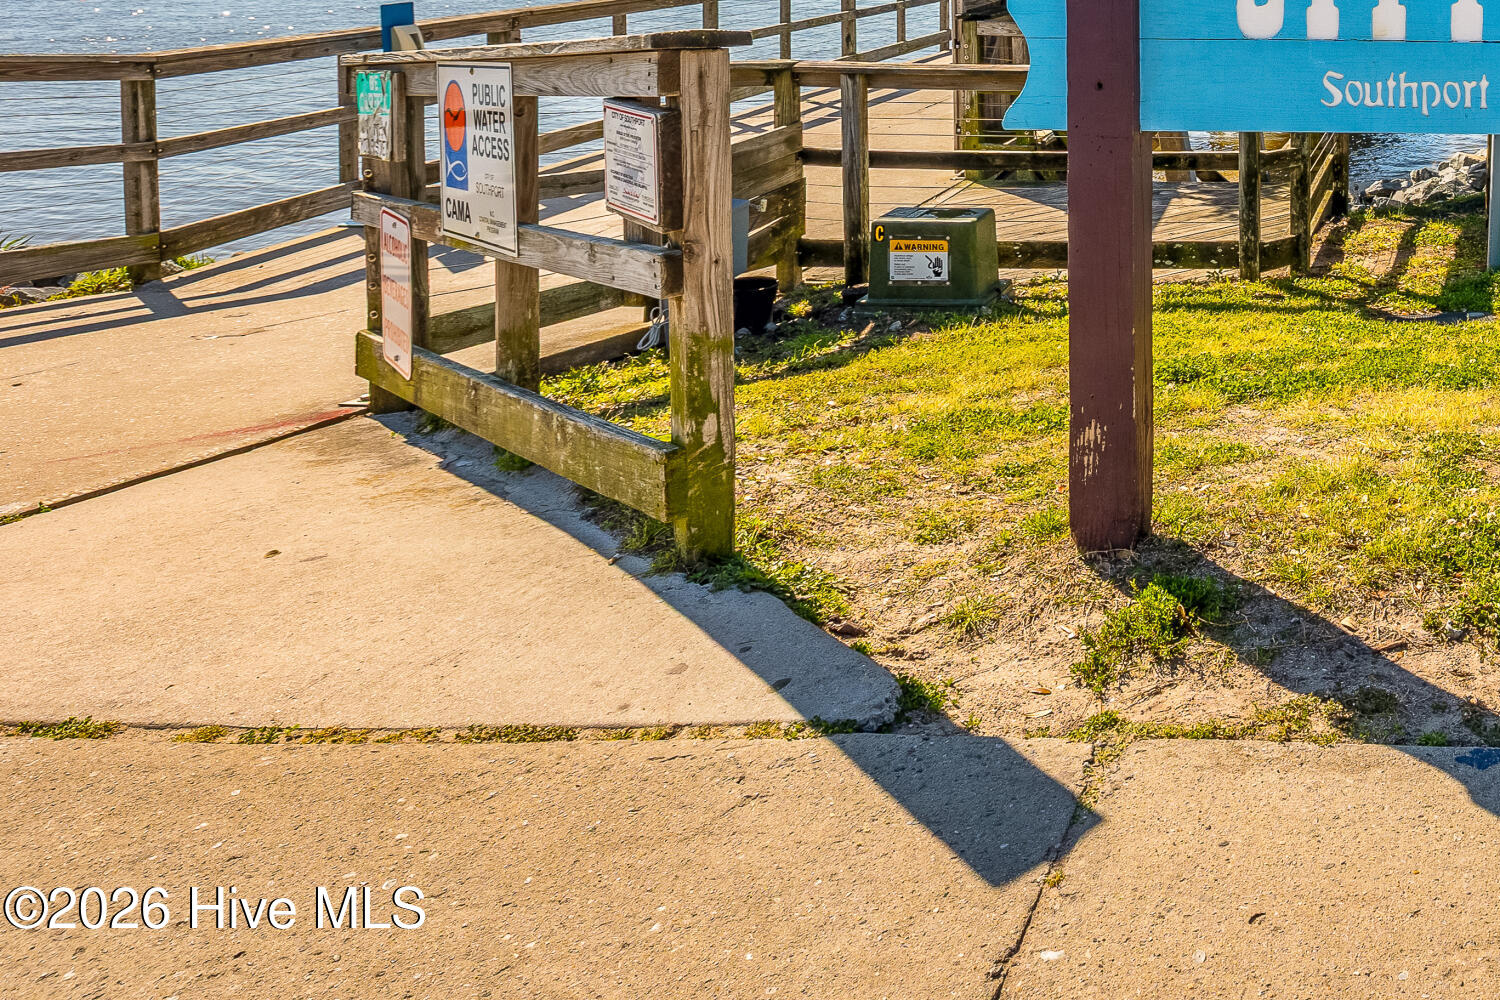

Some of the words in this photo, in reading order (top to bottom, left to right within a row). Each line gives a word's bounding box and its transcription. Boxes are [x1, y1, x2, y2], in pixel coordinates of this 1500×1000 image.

[471, 83, 506, 108] PUBLIC
[1320, 70, 1490, 117] Southport
[472, 109, 506, 134] WATER
[471, 134, 510, 161] ACCESS
[475, 181, 505, 199] SOUTHPORT
[445, 197, 472, 224] CAMA
[874, 225, 884, 242] C
[383, 231, 409, 265] ALCOHOLIC
[903, 243, 945, 251] WARNING
